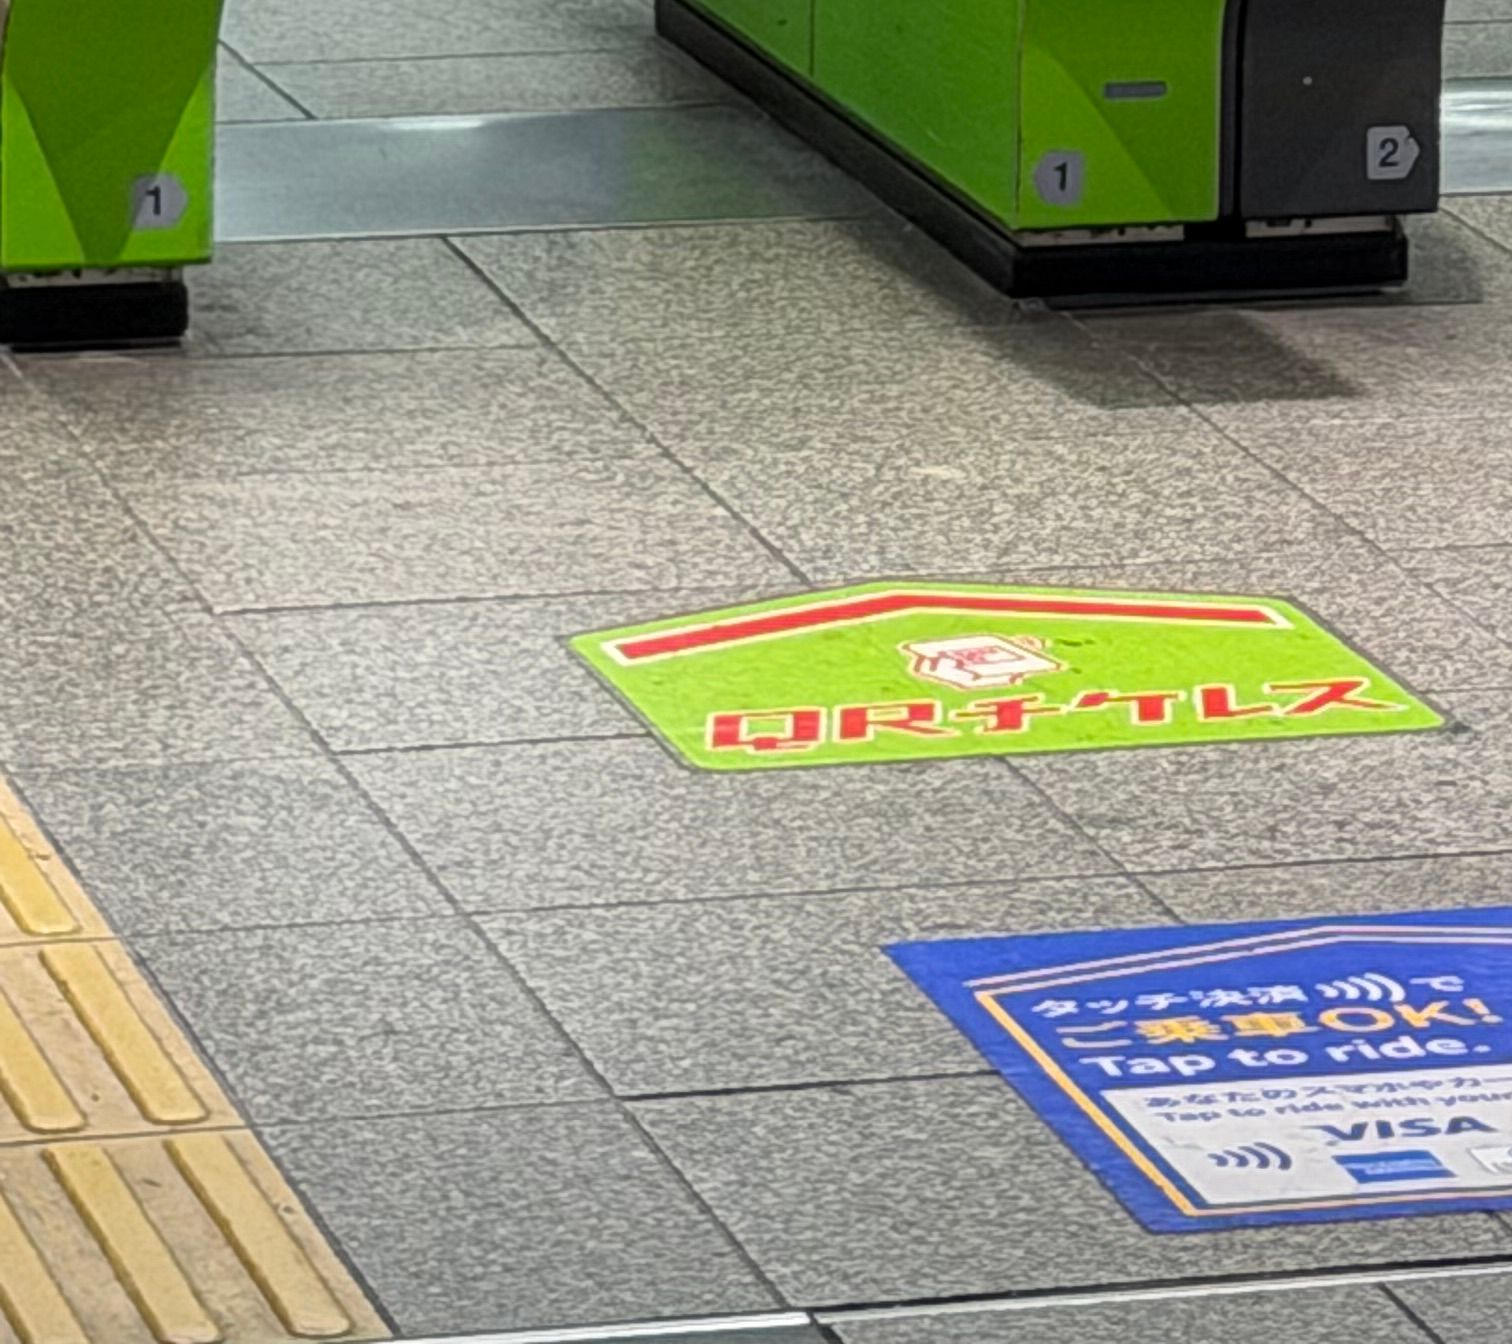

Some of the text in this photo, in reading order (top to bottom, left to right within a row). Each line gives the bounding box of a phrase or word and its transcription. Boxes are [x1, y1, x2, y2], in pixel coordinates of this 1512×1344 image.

[1378, 137, 1399, 168] 2
[1053, 162, 1068, 192] 1
[145, 185, 162, 216] 1
[708, 678, 1402, 753] QRチケレス
[1031, 985, 1308, 1018] タッチ決済
[1079, 1035, 1493, 1077] Tap to ride.
[1302, 1115, 1499, 1142] VISA
